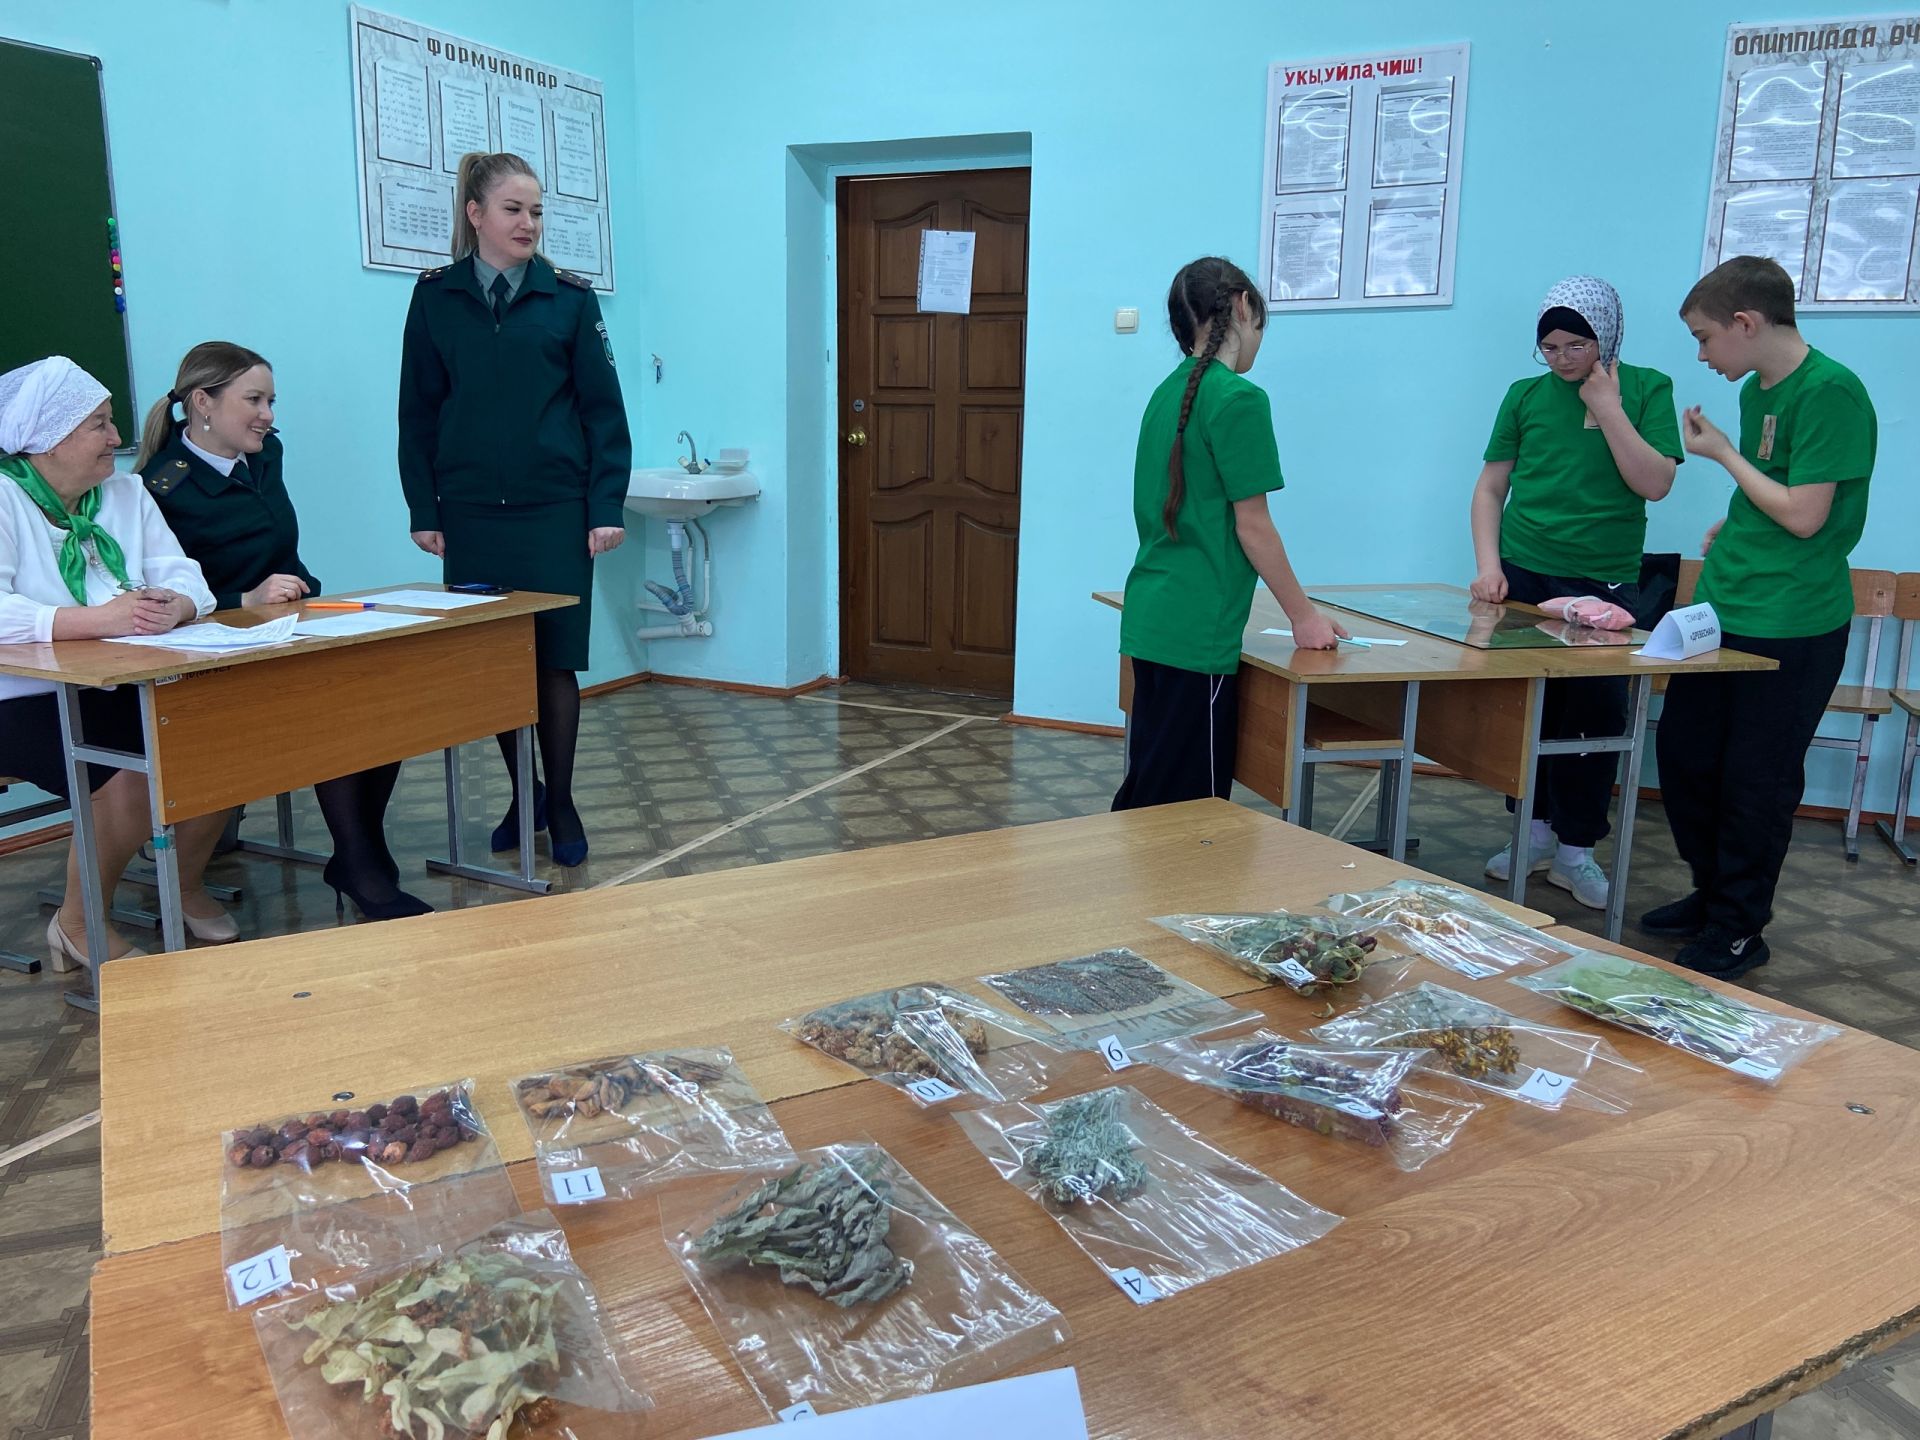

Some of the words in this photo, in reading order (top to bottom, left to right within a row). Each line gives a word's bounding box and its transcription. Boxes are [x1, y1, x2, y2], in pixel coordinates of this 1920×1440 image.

[1734, 26, 1877, 56] ОЛИМПИАДА
[1286, 963, 1304, 978] 8
[917, 1081, 949, 1096] 10
[1536, 1072, 1563, 1088] 2
[1348, 1103, 1372, 1114] 3
[563, 1174, 597, 1196] 11
[238, 1256, 281, 1290] 12
[1123, 1276, 1142, 1295] 4
